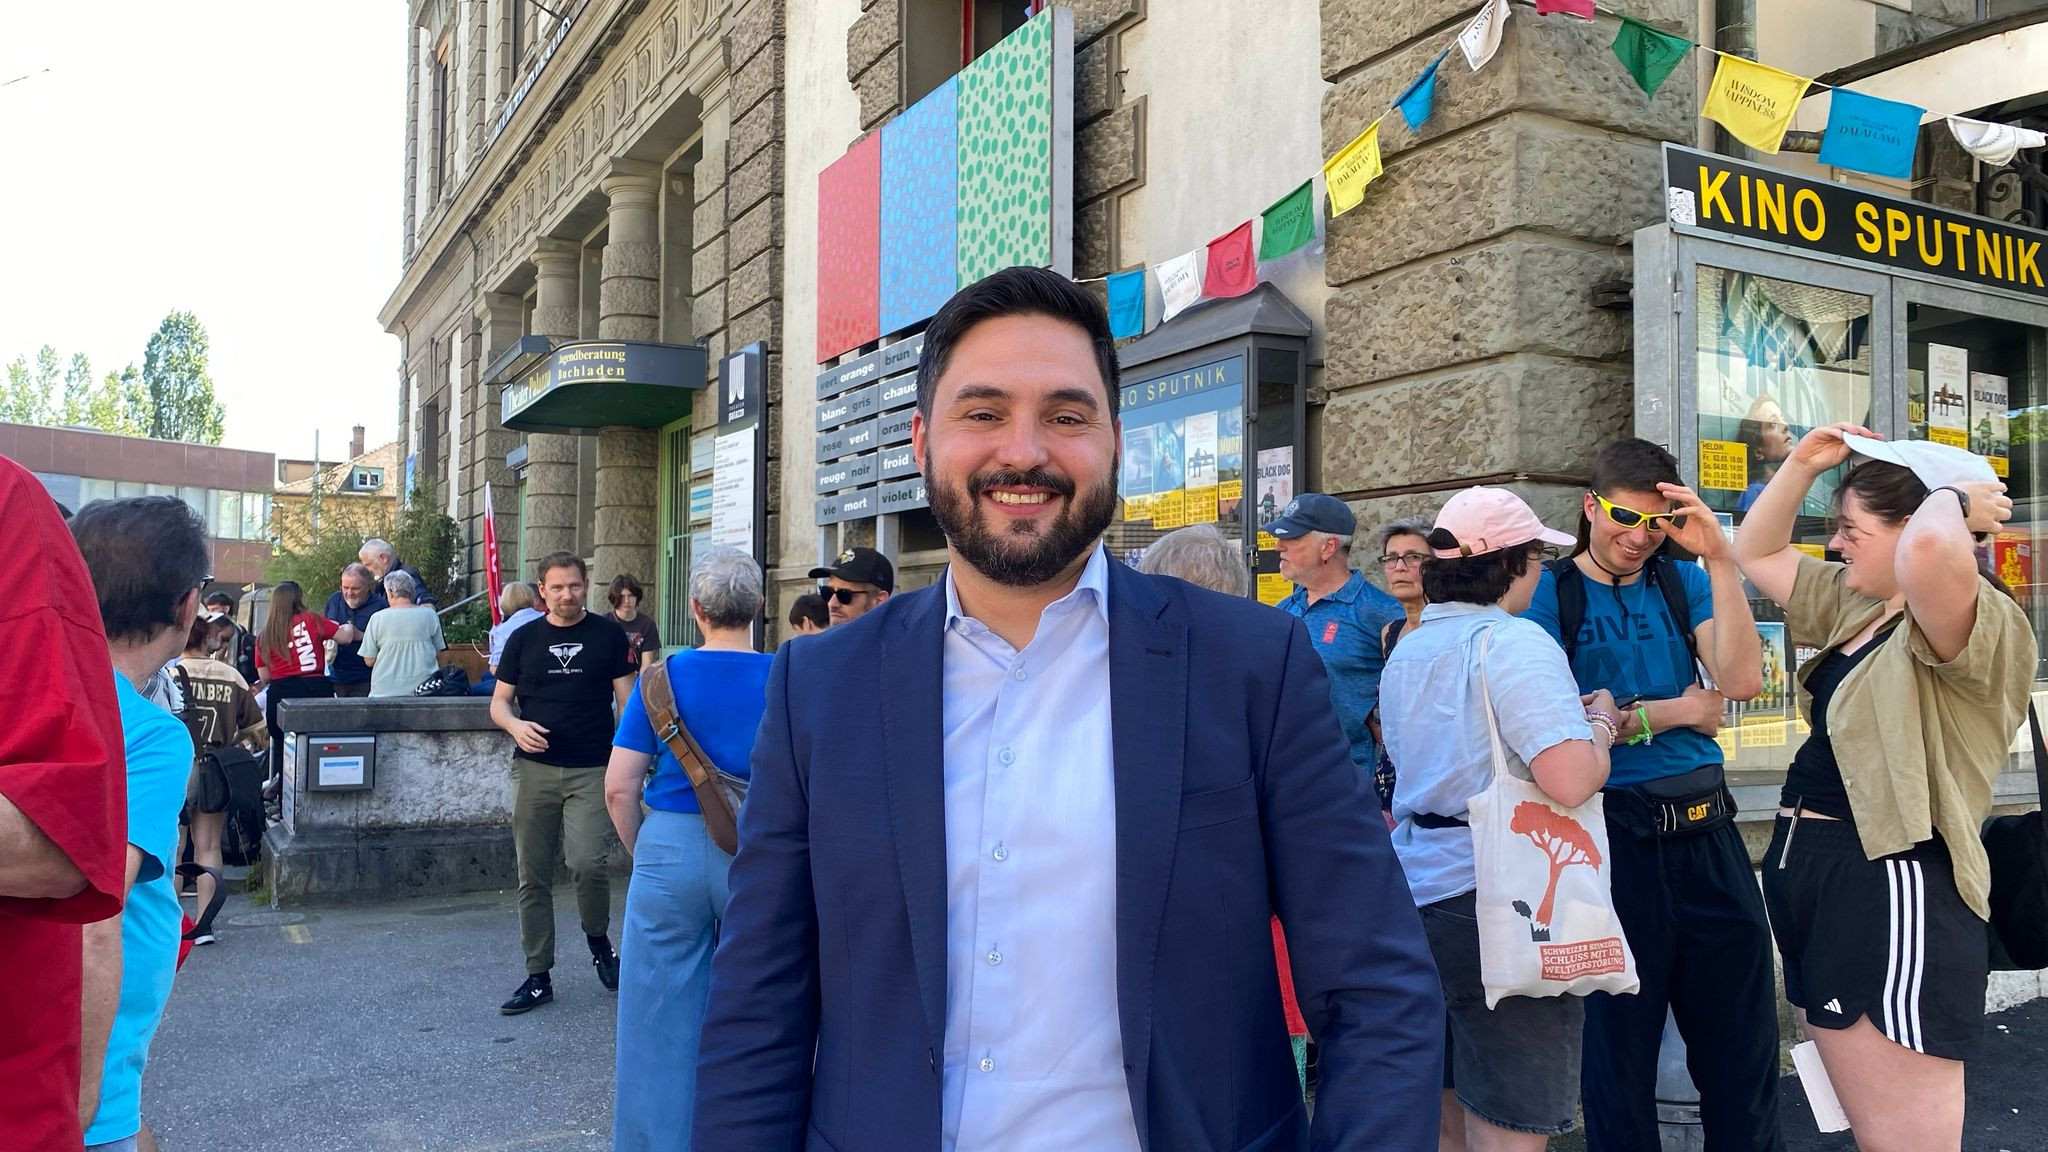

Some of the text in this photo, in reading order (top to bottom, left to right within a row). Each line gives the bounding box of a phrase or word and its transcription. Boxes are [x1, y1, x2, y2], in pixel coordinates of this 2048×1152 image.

[1730, 79, 1776, 108] WISDOM
[1724, 87, 1776, 120] HAPPINESS
[1699, 166, 1826, 242] KINO
[1856, 202, 2045, 288] SPUTNIK
[558, 350, 626, 366] Jugendberatung
[885, 349, 910, 366] brun
[558, 365, 625, 380] Buchladen
[820, 362, 875, 390] vert orange
[1147, 365, 1226, 402] SPUTNIK
[1974, 389, 2007, 406] BLACK DOG
[821, 397, 871, 422] blanc gris
[882, 420, 913, 436] orang
[823, 430, 869, 453] rose vert
[883, 454, 909, 470] froid
[820, 464, 871, 486] rouge noir
[1258, 464, 1291, 479] BLACK DOG
[882, 487, 913, 504] violet
[823, 498, 867, 516] vie mort
[1577, 611, 1675, 646] GIVE I
[195, 703, 218, 743] 7
[1687, 803, 1708, 821] CAT
[1543, 944, 1588, 956] SCHWEIZER
[1544, 952, 1588, 965] SCHLUSS
[1590, 949, 1608, 959] MIT
